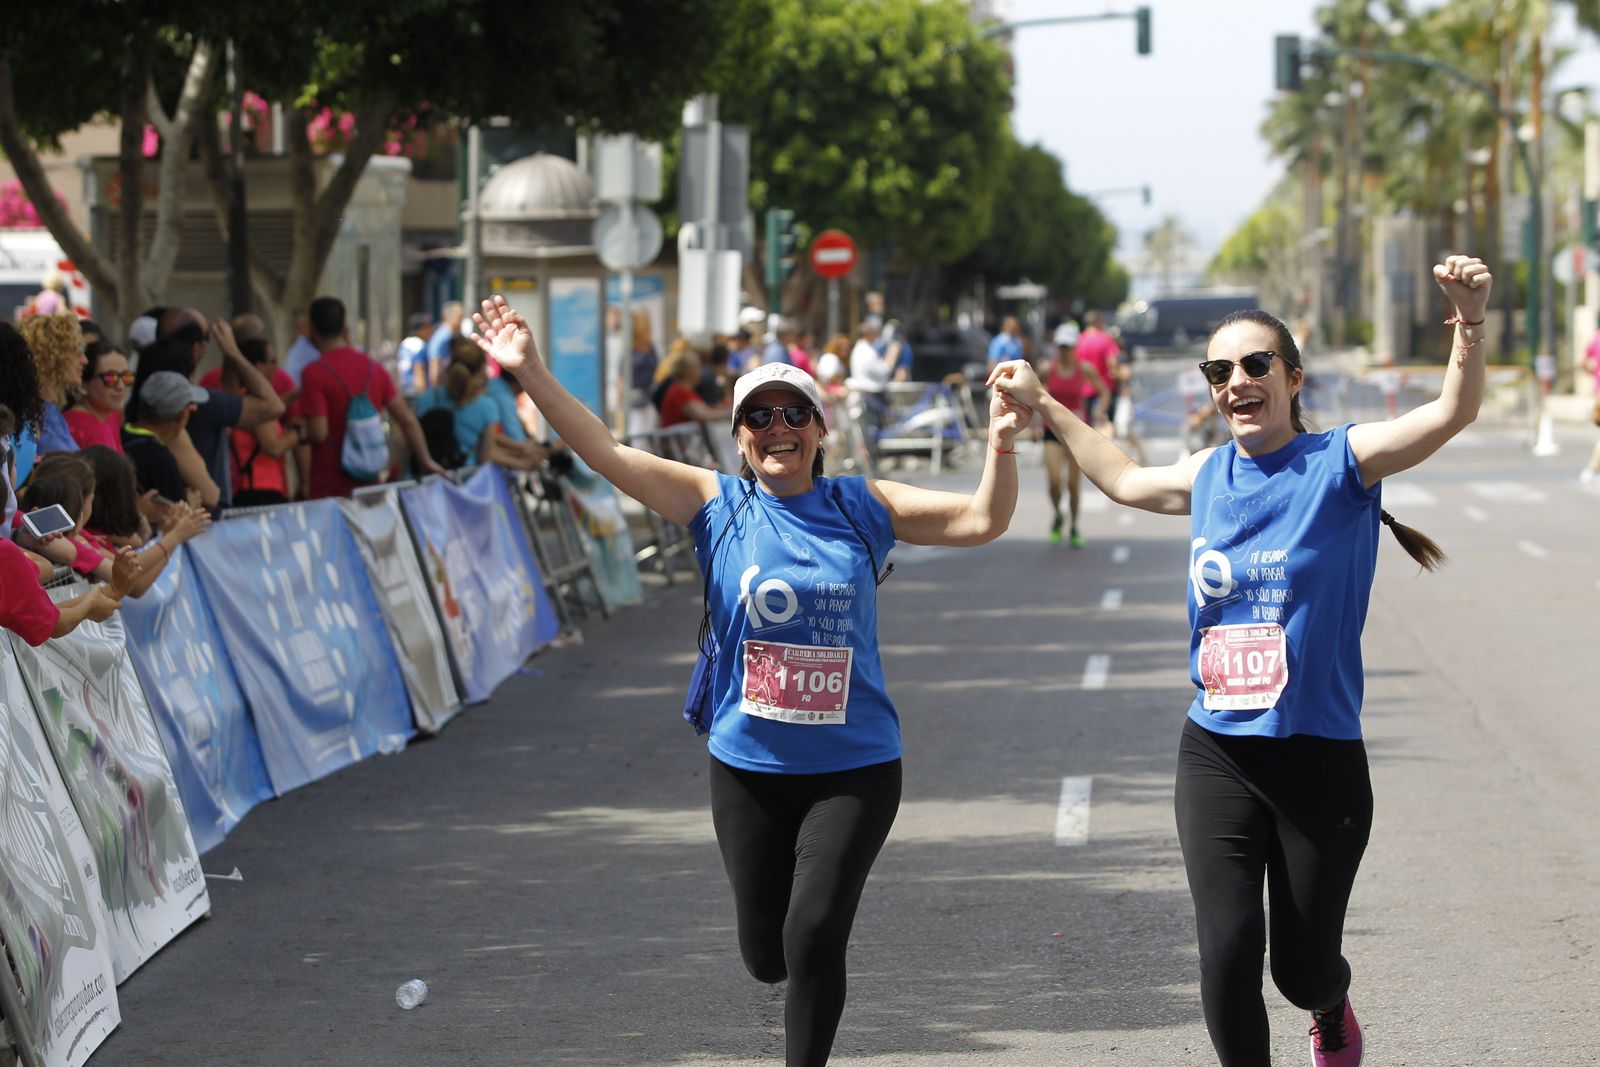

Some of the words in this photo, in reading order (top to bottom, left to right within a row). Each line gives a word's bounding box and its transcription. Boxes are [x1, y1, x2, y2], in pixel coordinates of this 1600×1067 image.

[1247, 568, 1259, 581] SIN
[1261, 566, 1287, 581] PENSAR
[816, 581, 826, 595] TÚ
[829, 582, 856, 596] RESPIRAS
[1244, 589, 1254, 601] YO
[1272, 588, 1293, 603] PIENSO
[815, 598, 826, 610] SIN
[1253, 605, 1260, 619] EN
[807, 615, 816, 627] YO
[812, 631, 821, 644] EN
[1221, 650, 1280, 675] 1107
[775, 668, 843, 693] 1106
